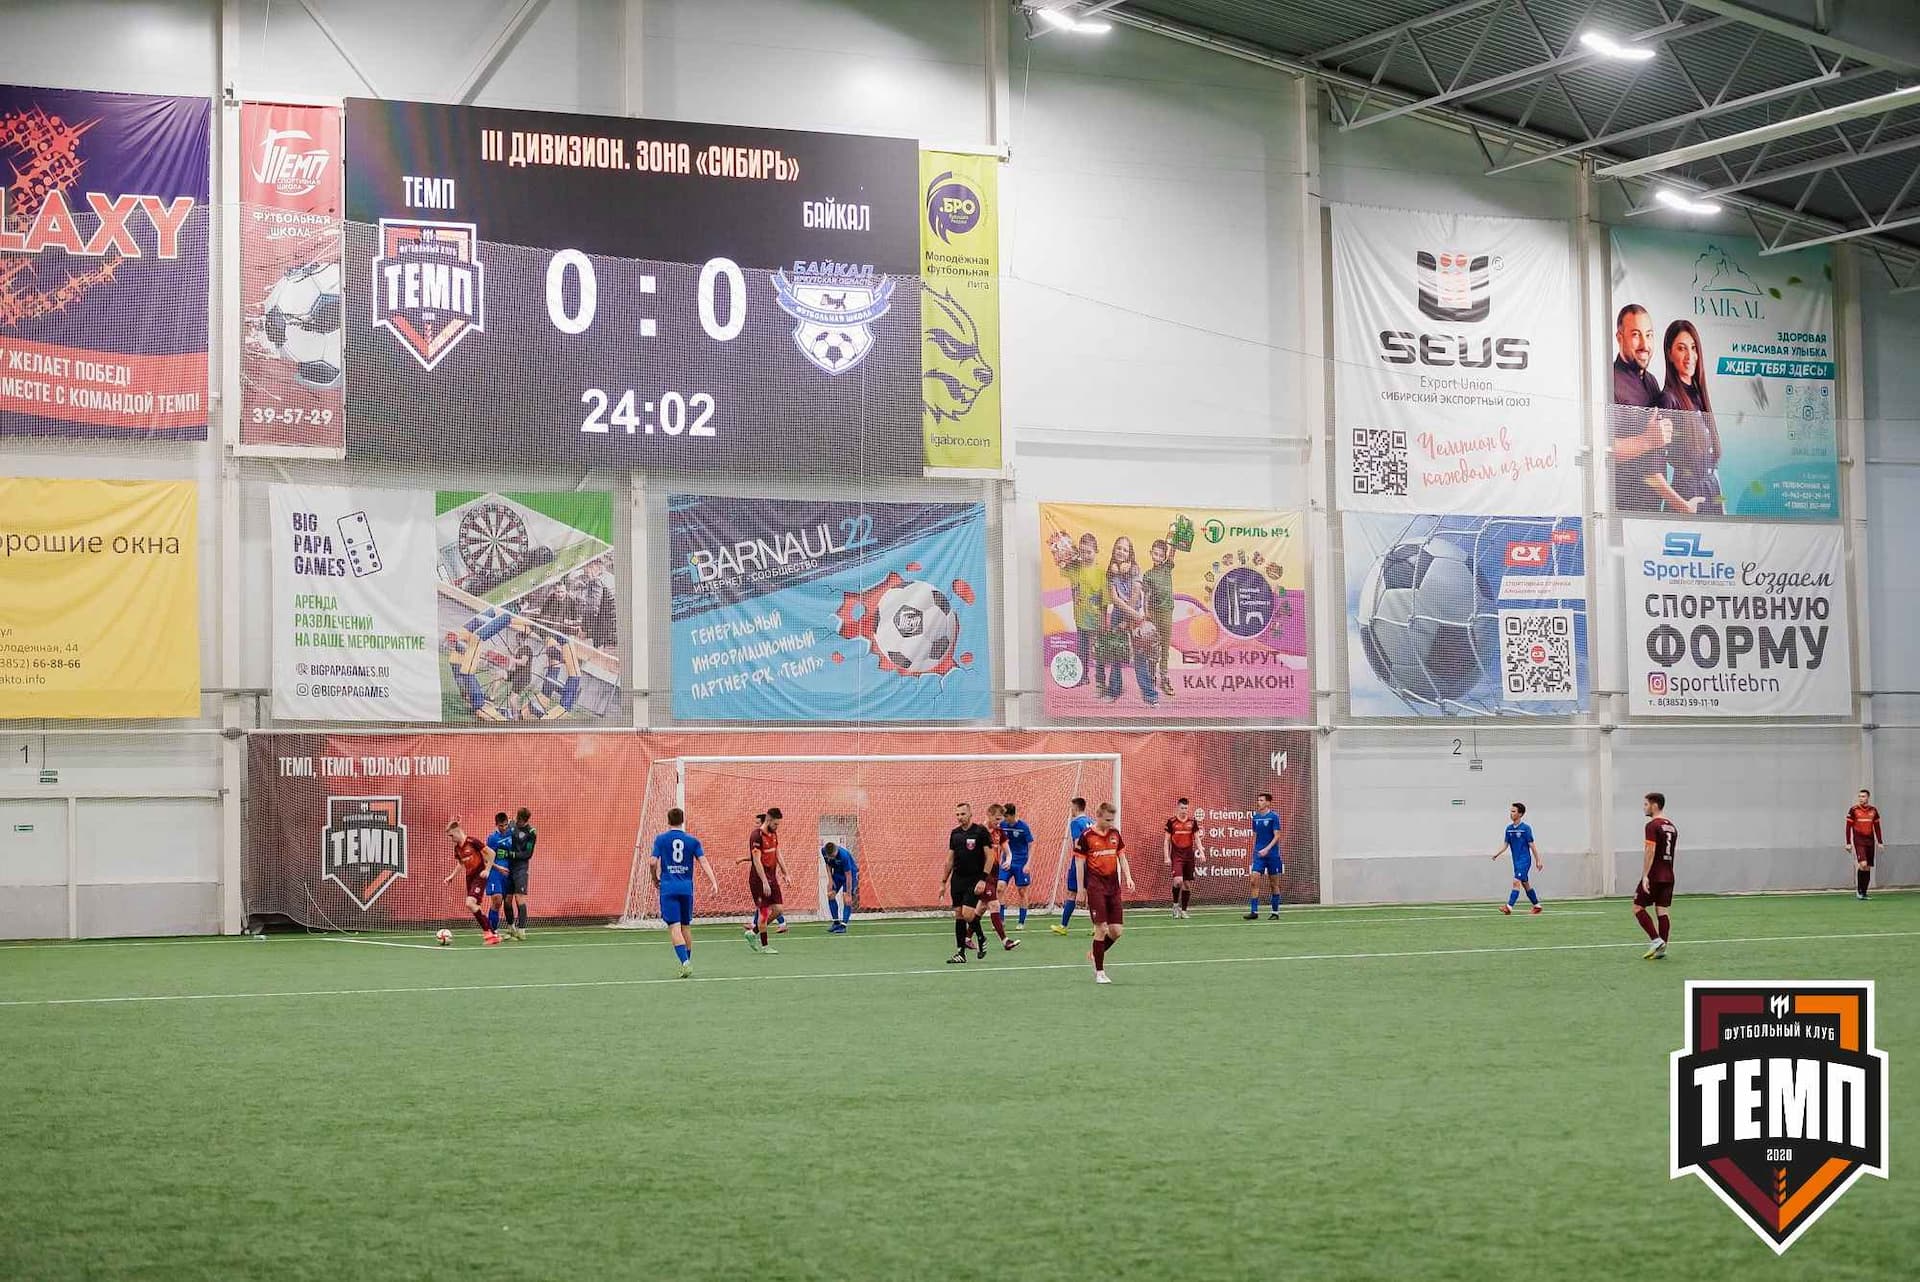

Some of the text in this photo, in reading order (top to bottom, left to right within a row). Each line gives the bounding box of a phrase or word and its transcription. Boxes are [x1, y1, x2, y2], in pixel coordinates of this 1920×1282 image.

[482, 130, 800, 181] III ДИВИЗИОН. ЗОНА «СИБИРЬ»
[403, 176, 455, 209] ТЕМП
[0, 187, 195, 259] LAXY
[253, 211, 331, 225] ФУТБОЛЬНАЯ
[803, 197, 870, 231] БАЙКАЛ
[270, 227, 311, 238] ШКОЛА
[926, 251, 989, 265] Молодёжная
[793, 259, 874, 278] БАЙКАЛ
[928, 264, 989, 277] футбольная
[384, 263, 472, 316] ТЕМП
[968, 280, 989, 290] лига
[546, 249, 597, 334] 0
[699, 257, 746, 341] 0
[1777, 332, 1827, 344] ЗДОРОВАЯ
[1380, 329, 1530, 370] SEUS
[1732, 344, 1827, 358] И КРАСИВАЯ УЛЫБКА
[9, 350, 70, 378] ЖЕЛАЕТ
[76, 361, 131, 386] ПОБЕД!
[1725, 360, 1827, 377] ЖДЕТ ТЕБЯ ЗДЕСЬ!
[1420, 375, 1492, 392] Export Union
[56, 386, 65, 405] С
[70, 388, 153, 415] КОМАНДОЙ
[158, 393, 200, 413] ТЕМП!
[1381, 391, 1530, 407] СИБИРСКИЙ ЭКСПОРТНЫЙ СОЮЗ
[252, 408, 332, 425] 39-57-29
[580, 389, 716, 436] 24:02
[931, 432, 990, 447] ligabro.com
[1417, 426, 1511, 459] Чемпион в
[1423, 444, 1558, 486] каждом из нас!
[293, 512, 318, 532] BIG
[1230, 527, 1267, 537] ГРИЛЬ
[113, 535, 179, 554] окна
[294, 535, 332, 555] PAPA
[295, 556, 346, 577] GAMES
[1643, 560, 1735, 580] SportLife
[1741, 562, 1833, 594] Создаем
[295, 594, 337, 611] АРЕНДА
[1645, 594, 1830, 620] СПОРТИВНУЮ
[295, 614, 373, 630] РАЗВЛЕЧЕНИЙ
[691, 608, 782, 646] ГЕНЕРАЛЬНЫЙ
[66, 643, 78, 652] 44
[295, 633, 426, 650] НА ВАШЕ МЕРОПРИЯТИЕ
[1647, 624, 1829, 669] ФОРМУ
[691, 629, 815, 674] ИНФОРМАЦИОННЫЙ
[1182, 650, 1283, 668] БУДЬ КРУТ,
[33, 659, 80, 669] 66-88-66
[310, 665, 390, 678] BIGPAPAGAMES.RU
[691, 655, 823, 701] ПАРТНЕР ФК «ТЕМП»
[1184, 675, 1295, 692] КАК ДРАКОН!
[1670, 673, 1779, 696] sportlifebrn
[311, 684, 389, 698] @BIGPAPAGAMES
[1658, 698, 1687, 707] 8(3852)
[1689, 699, 1719, 707] 59-11-10
[20, 745, 28, 763] 1
[1453, 738, 1462, 755] 2
[279, 757, 450, 778] ТЕМП, ТЕМП, ТОЛЬКО ТЕМП!
[1210, 827, 1253, 838] ФК Темп
[331, 829, 398, 867] ТЕМП
[672, 839, 684, 863] 8
